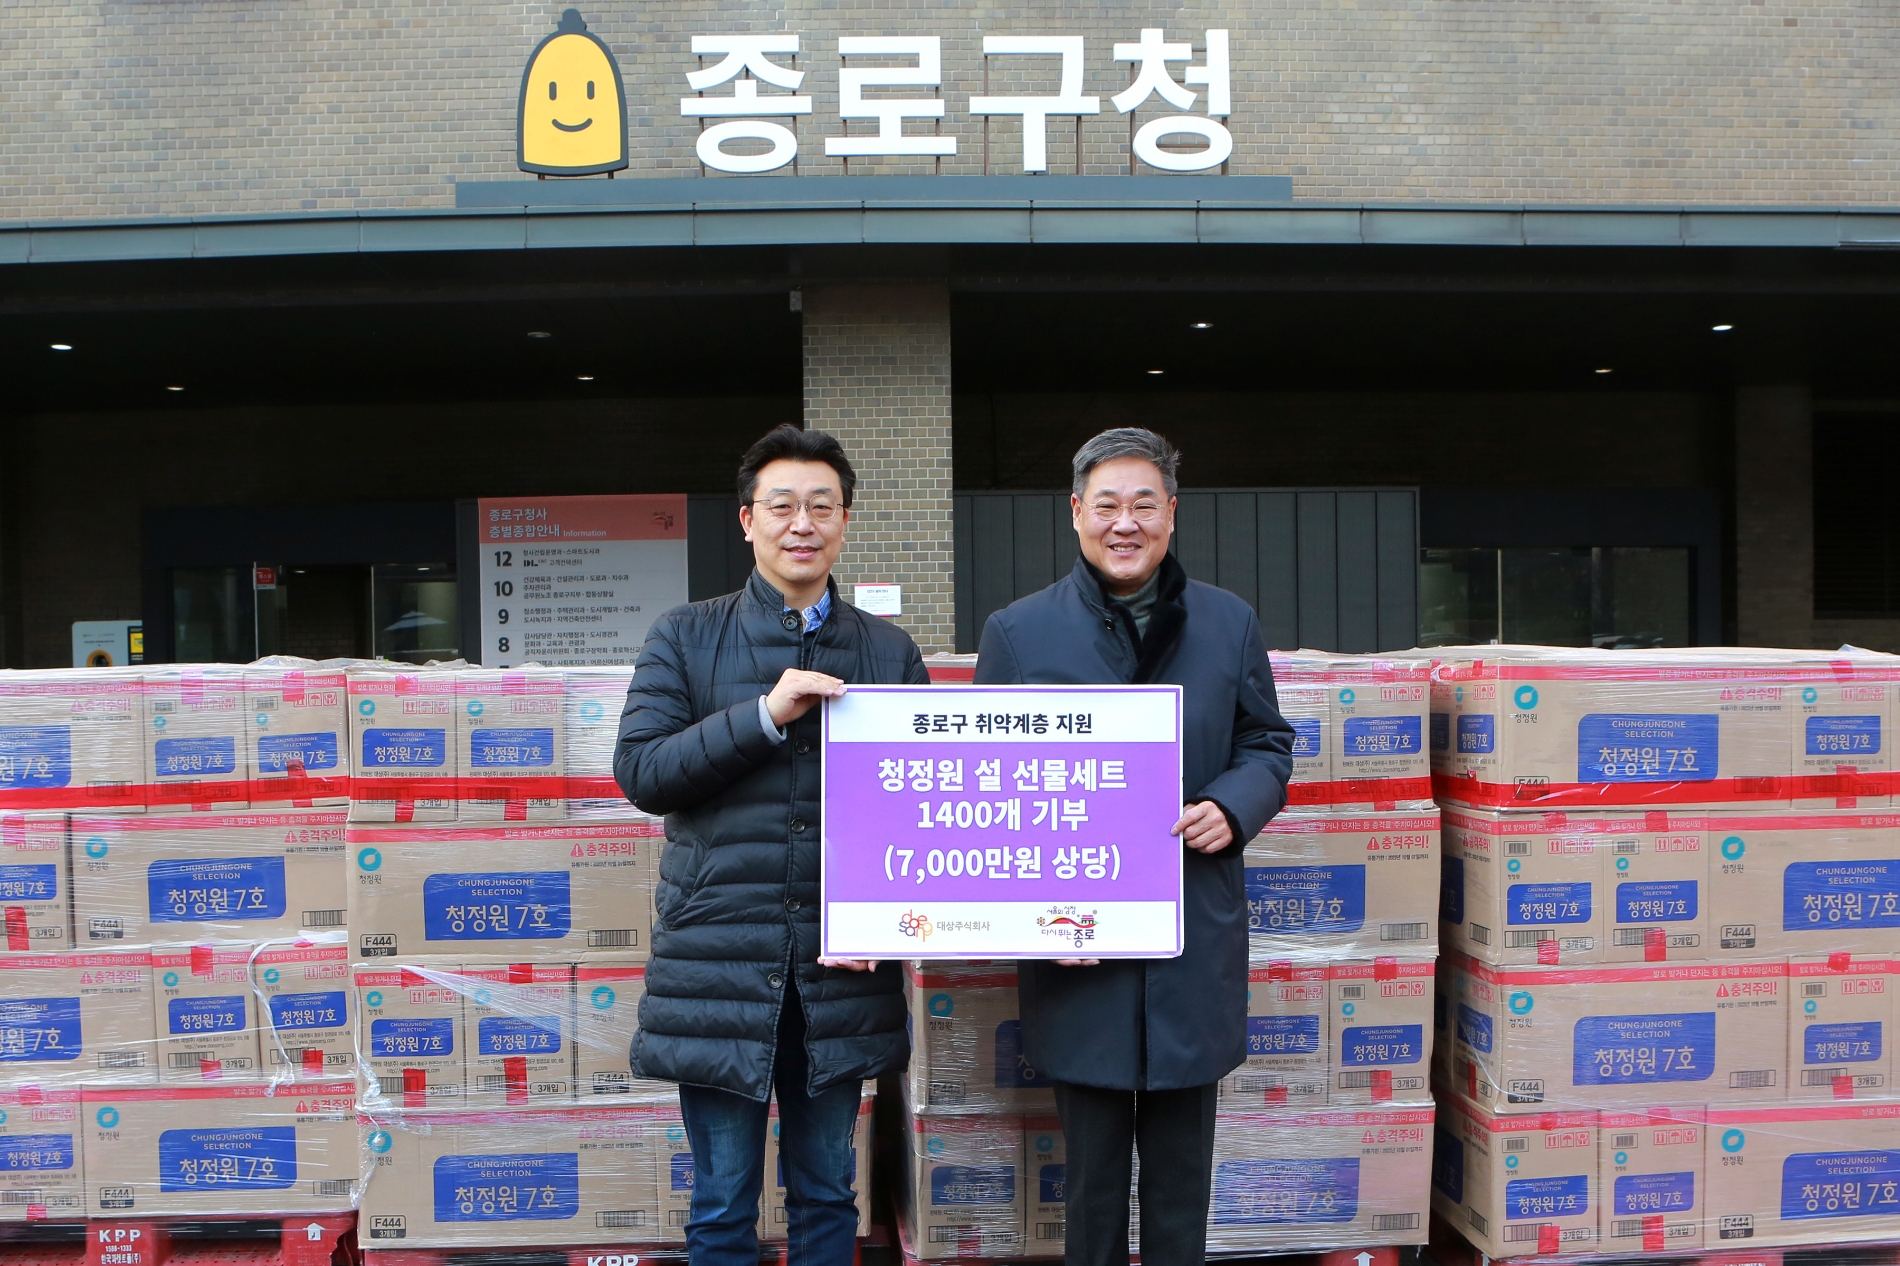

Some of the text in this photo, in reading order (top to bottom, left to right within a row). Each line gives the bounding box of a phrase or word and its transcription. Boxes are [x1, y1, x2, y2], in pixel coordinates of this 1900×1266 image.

[681, 28, 1233, 172] 종로구청
[489, 508, 547, 522] 종로구청사
[489, 525, 607, 538] 층별종합안내 Information
[494, 551, 513, 567] 12
[494, 581, 514, 597] 10
[498, 609, 509, 625] 9
[498, 637, 510, 653] 8
[912, 713, 1093, 735] 종로구 취약계층 지원
[1514, 714, 1538, 724] 청정원
[1612, 720, 1686, 728] CHUNGJUNGONE
[1624, 730, 1674, 738] SELECTION
[1355, 734, 1412, 752] 청정원 7호
[1816, 734, 1871, 750] 청정원 7호
[374, 746, 434, 763] 청정원 7호
[482, 746, 543, 763] 청정원 7호
[1598, 747, 1699, 776] 청정원 7호
[877, 758, 1128, 792] 청정원 설 선물세트
[420, 798, 442, 807] 3개입
[530, 798, 551, 807] 3개입
[916, 798, 1090, 832] 1400개 기부
[1382, 835, 1429, 850] 충격주의!
[586, 842, 636, 857] 충격주의!
[179, 863, 252, 872] CHUNGJUNGONE
[884, 844, 1121, 885] (7,000만원 상당)
[1722, 864, 1744, 874] 청정원
[1816, 866, 1888, 876] CHUNGJUNGONE
[192, 872, 241, 880] SELECTION
[359, 874, 382, 884] 청정원
[457, 878, 535, 887] CHUNGJUNGONE
[1256, 872, 1332, 881] CHUNGJUNGONE
[1828, 876, 1876, 885] SELECTION
[471, 888, 523, 896] SELECTION
[1269, 882, 1320, 890] SELECTION
[168, 887, 268, 916] 청정원 7호
[1803, 892, 1900, 922] 청정원 7호
[1247, 898, 1346, 928] 청정원 7호
[1519, 902, 1581, 920] 청정원 7호
[1628, 900, 1688, 918] 청정원 7호
[445, 904, 551, 932] 청정원 7호
[936, 921, 991, 932] 대상주식회사
[1725, 927, 1752, 938] F444
[364, 936, 392, 947] F444
[1058, 929, 1072, 940] 뛰는
[1073, 929, 1095, 948] 종로
[1672, 936, 1693, 946] 3개입
[94, 970, 142, 984] 충격주의!
[1690, 968, 1710, 977] 던지는
[1712, 968, 1719, 976] 등
[1720, 967, 1740, 976] 충격을
[1731, 982, 1778, 996] 충격주의!
[178, 1012, 236, 1030] 청정원 7호
[281, 1008, 338, 1026] 청정원 7호
[1508, 1018, 1533, 1028] 청정원
[1608, 1021, 1683, 1030] CHUNGJUNGONE
[1620, 1030, 1670, 1039] SELECTION
[382, 1035, 443, 1052] 청정원 7호
[490, 1034, 550, 1051] 청정원 7호
[1353, 1043, 1411, 1062] 청정원 7호
[1815, 1041, 1872, 1059] 청정원 7호
[225, 1058, 246, 1069] 3개입
[326, 1054, 348, 1064] 3개입
[1594, 1046, 1696, 1077] 청정원 7호
[538, 1083, 559, 1093] 3개입
[1396, 1078, 1418, 1089] 3개입
[1512, 1082, 1540, 1092] F444
[191, 1133, 264, 1142] CHUNGJUNGONE
[204, 1142, 252, 1150] SELECTION
[467, 1160, 544, 1169] CHUNGJUNGONE
[1816, 1156, 1888, 1166] CHUNGJUNGONE
[179, 1156, 279, 1185] 청정원 7호
[480, 1169, 532, 1177] SELECTION
[1828, 1166, 1876, 1175] SELECTION
[104, 1188, 131, 1199] F444
[454, 1184, 560, 1214] 청정원 7호
[1802, 1181, 1899, 1211] 청정원 7호
[1518, 1194, 1578, 1214] 청정원 7호
[1626, 1191, 1684, 1210] 청정원 7호
[374, 1218, 402, 1228] F444
[1724, 1218, 1749, 1228] F444
[99, 1229, 142, 1243] KPP
[587, 1254, 639, 1266] KPP
